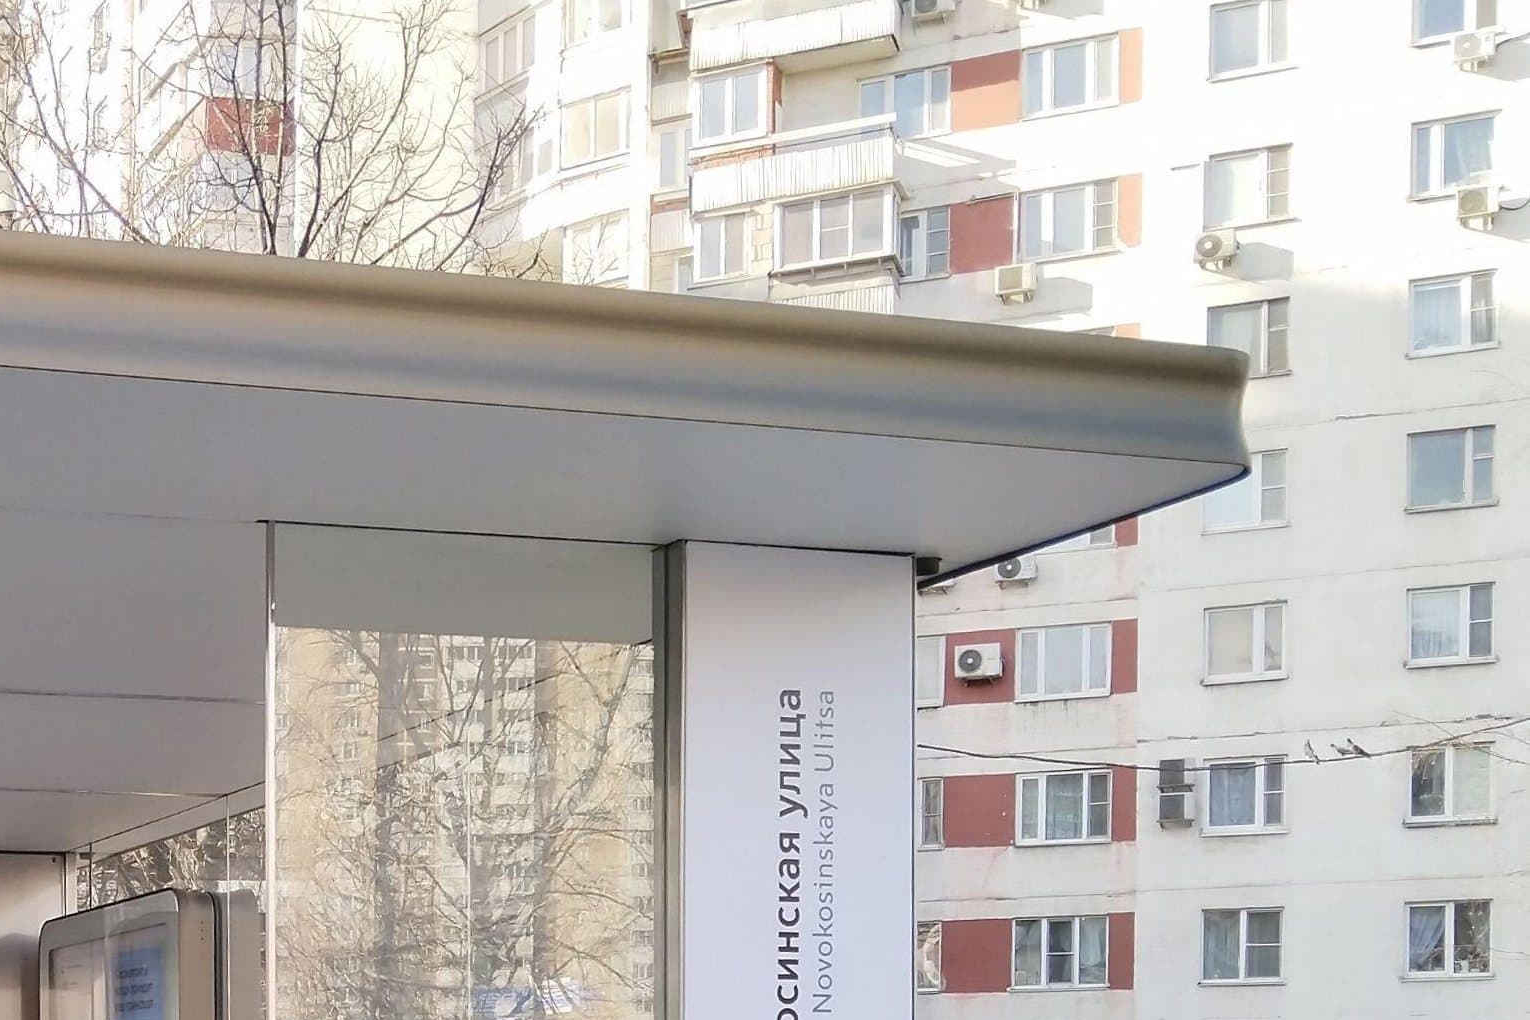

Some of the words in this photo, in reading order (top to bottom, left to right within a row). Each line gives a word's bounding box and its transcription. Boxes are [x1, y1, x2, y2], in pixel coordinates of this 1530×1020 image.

[777, 688, 809, 818] улица
[814, 689, 836, 772] Ulitsa
[812, 782, 839, 1014] Novokosinskaya
